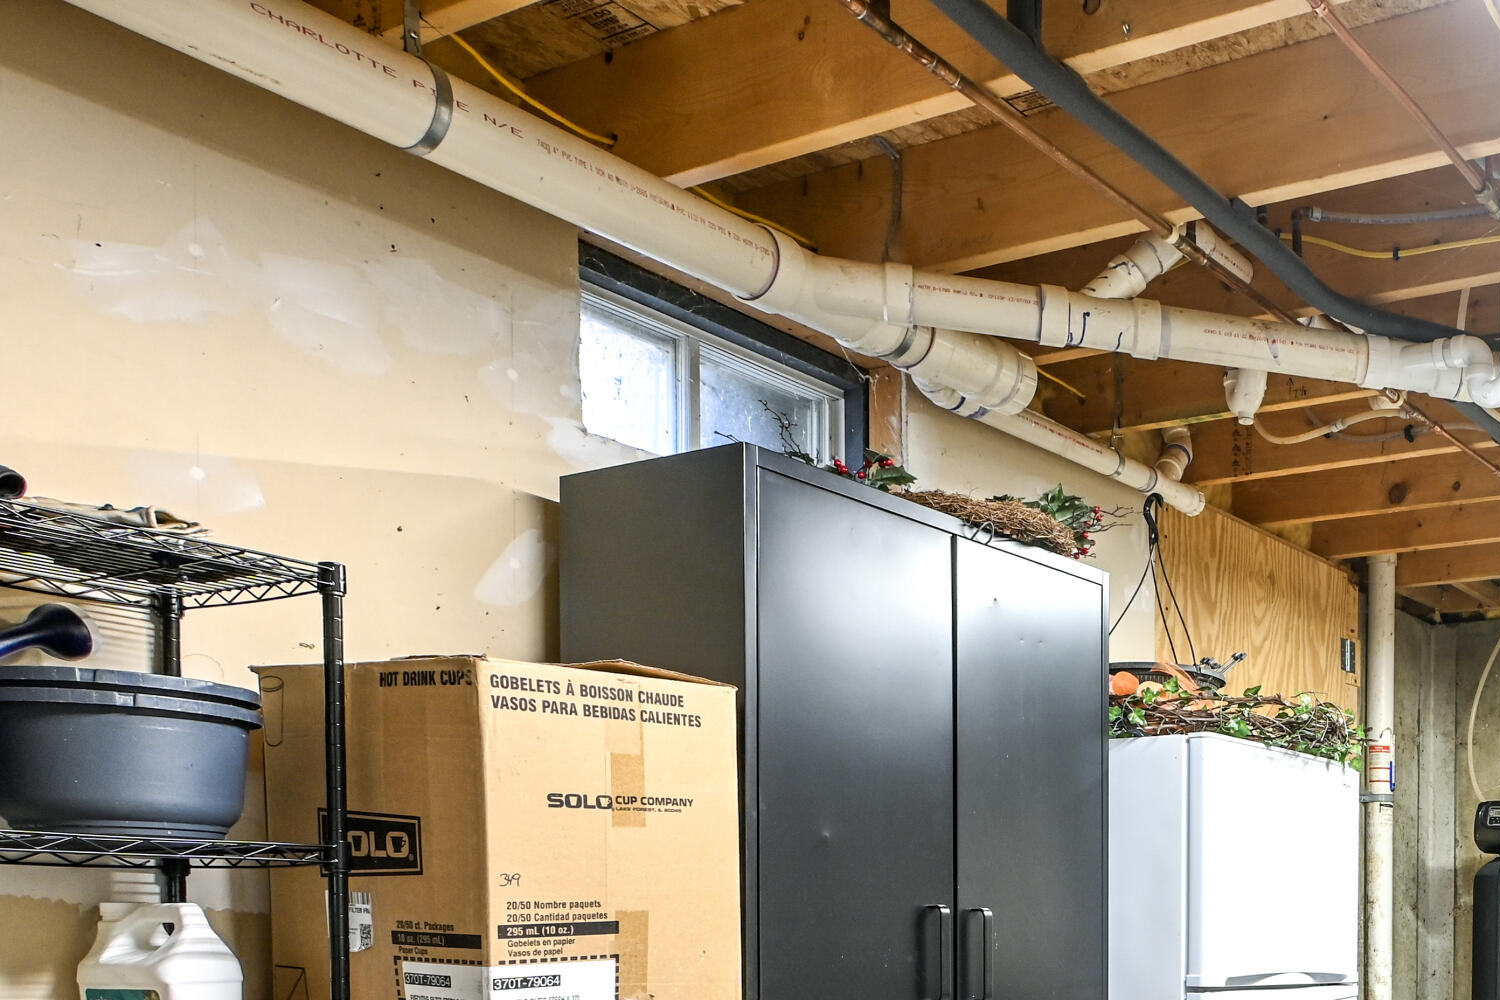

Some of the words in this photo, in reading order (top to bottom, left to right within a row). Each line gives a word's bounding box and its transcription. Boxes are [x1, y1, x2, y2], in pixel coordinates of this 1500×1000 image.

[250, 2, 398, 79] CHARLOTTE
[412, 79, 470, 113] PIE
[483, 112, 524, 139] N/E
[379, 671, 399, 687] HOT
[402, 669, 437, 687] DRINK
[440, 668, 473, 686] CUPS
[489, 673, 562, 695] GOBELETS
[565, 678, 575, 696] À
[579, 683, 634, 703] BOISSON
[637, 690, 685, 708] CHAUDE
[490, 695, 538, 713] VASOS
[541, 700, 578, 717] PARA
[582, 705, 637, 722] BEBIDAS
[640, 709, 702, 728] CALIENTES
[546, 793, 613, 810] SOLO
[615, 795, 638, 805] CUP
[640, 796, 694, 807] COMPANY
[346, 830, 410, 859] OLO
[506, 901, 532, 910] 20/50
[533, 900, 567, 910] Nombre
[569, 900, 602, 910] paquets
[506, 913, 532, 923] 20/50
[533, 912, 570, 922] Cantidad
[571, 912, 609, 922] paquetes
[423, 921, 455, 933] Packages
[506, 927, 524, 936] 295
[525, 926, 540, 936] mL
[541, 926, 556, 936] (10
[557, 925, 575, 935] oz.)
[507, 939, 541, 948] Gobelets
[553, 938, 576, 947] papier
[398, 945, 414, 955] Paper
[414, 946, 428, 956] Cups
[507, 950, 531, 958] Vasos
[532, 949, 542, 957] de
[543, 947, 564, 957] papel
[404, 973, 452, 987] 370T-79064
[493, 975, 561, 990] 370T-79064
